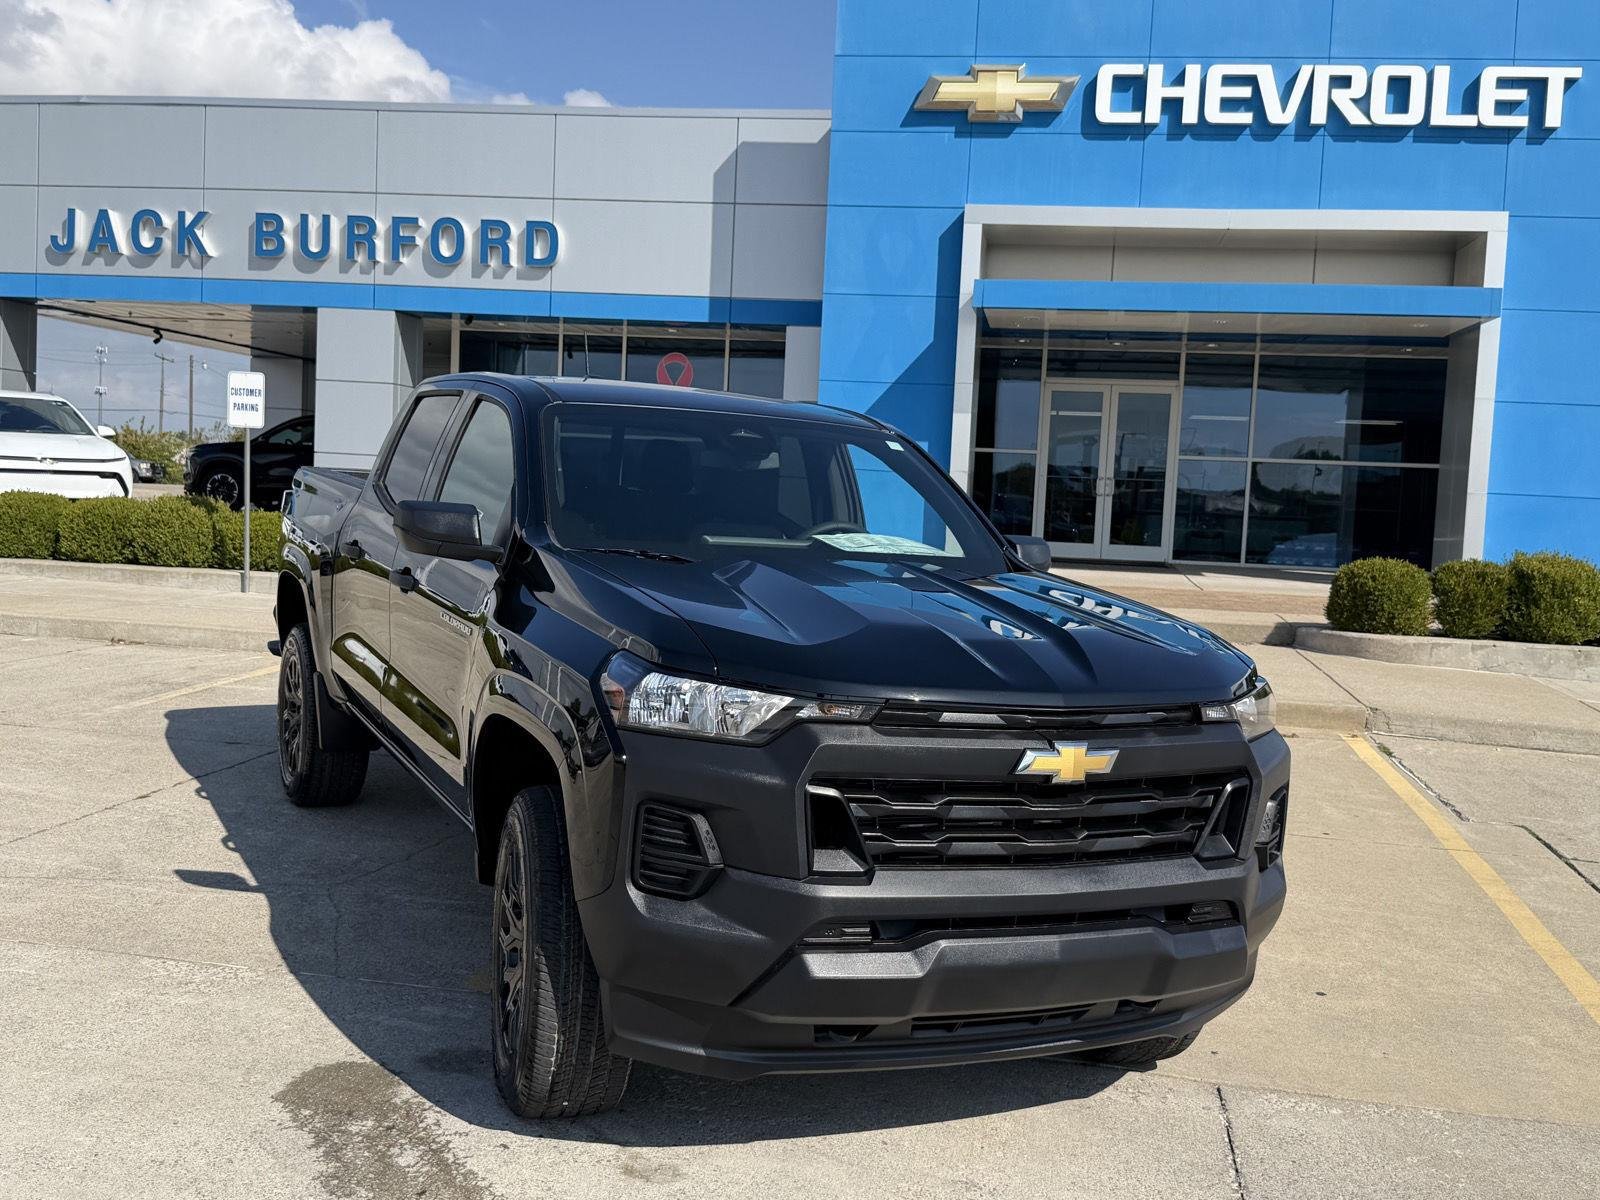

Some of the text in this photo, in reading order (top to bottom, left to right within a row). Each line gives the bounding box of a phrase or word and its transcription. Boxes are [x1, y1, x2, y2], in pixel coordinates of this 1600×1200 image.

[1094, 63, 1582, 129] CHEVROLET
[49, 207, 559, 268] JACK BURFORD
[230, 387, 262, 398] CUSTOMER
[233, 402, 259, 413] PARKING
